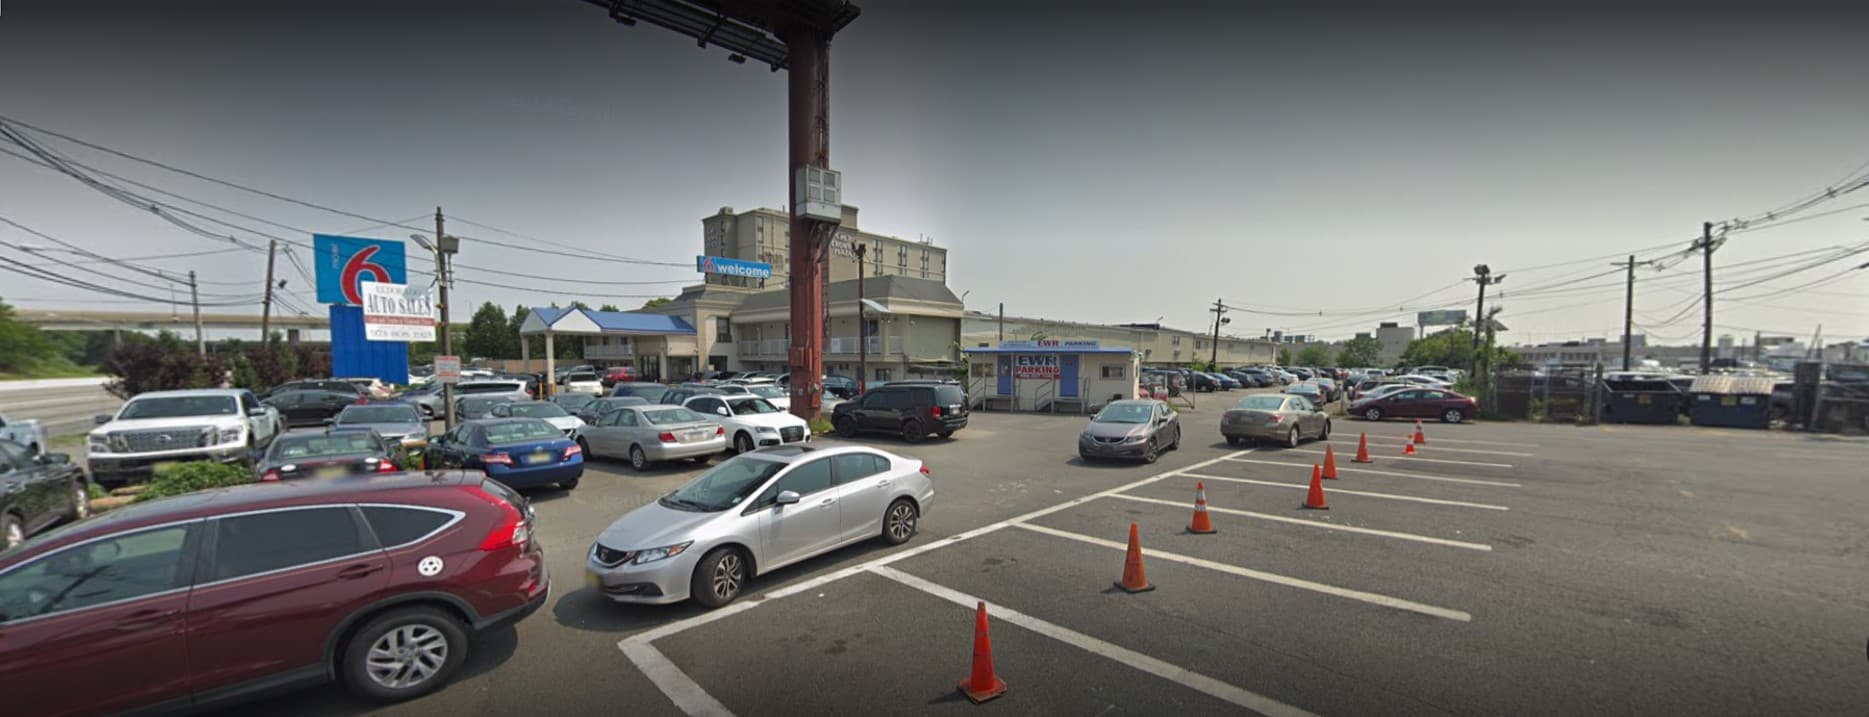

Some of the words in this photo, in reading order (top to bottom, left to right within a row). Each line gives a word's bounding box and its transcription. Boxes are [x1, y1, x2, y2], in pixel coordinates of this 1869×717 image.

[717, 263, 769, 278] welcome
[367, 293, 396, 314] AUTO
[1037, 339, 1059, 347] EWR
[1018, 355, 1057, 366] EWR
[1015, 366, 1060, 374] PARKING
